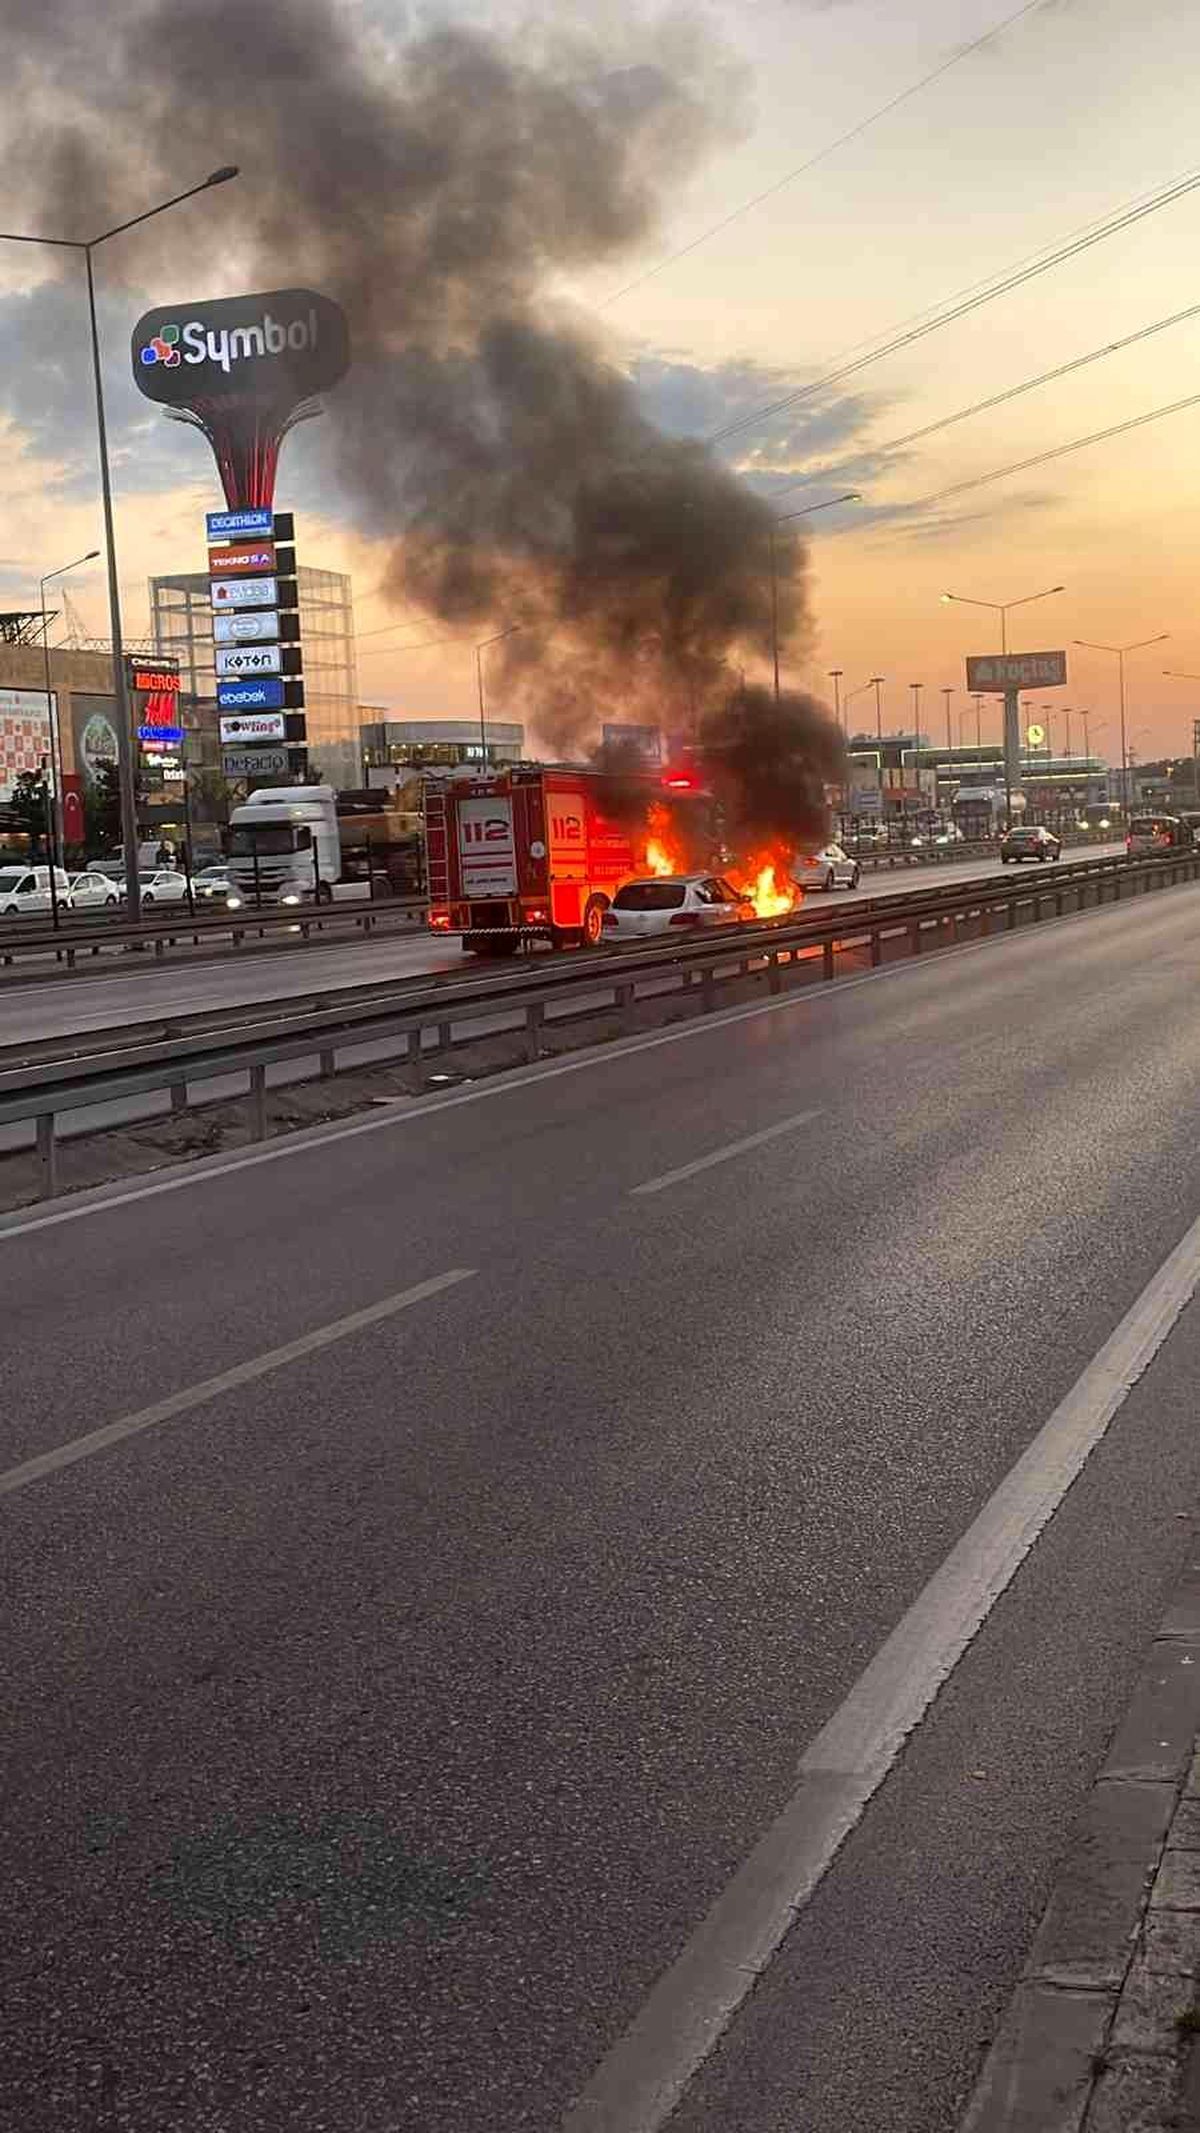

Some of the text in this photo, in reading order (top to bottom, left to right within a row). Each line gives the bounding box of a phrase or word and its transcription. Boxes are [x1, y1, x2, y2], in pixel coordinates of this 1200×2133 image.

[182, 308, 318, 373] Symbol
[211, 512, 268, 529] DECATHLON
[224, 654, 272, 669] KOTON
[219, 689, 266, 705] ebebek
[463, 818, 510, 843] 112
[551, 816, 581, 841] 112
